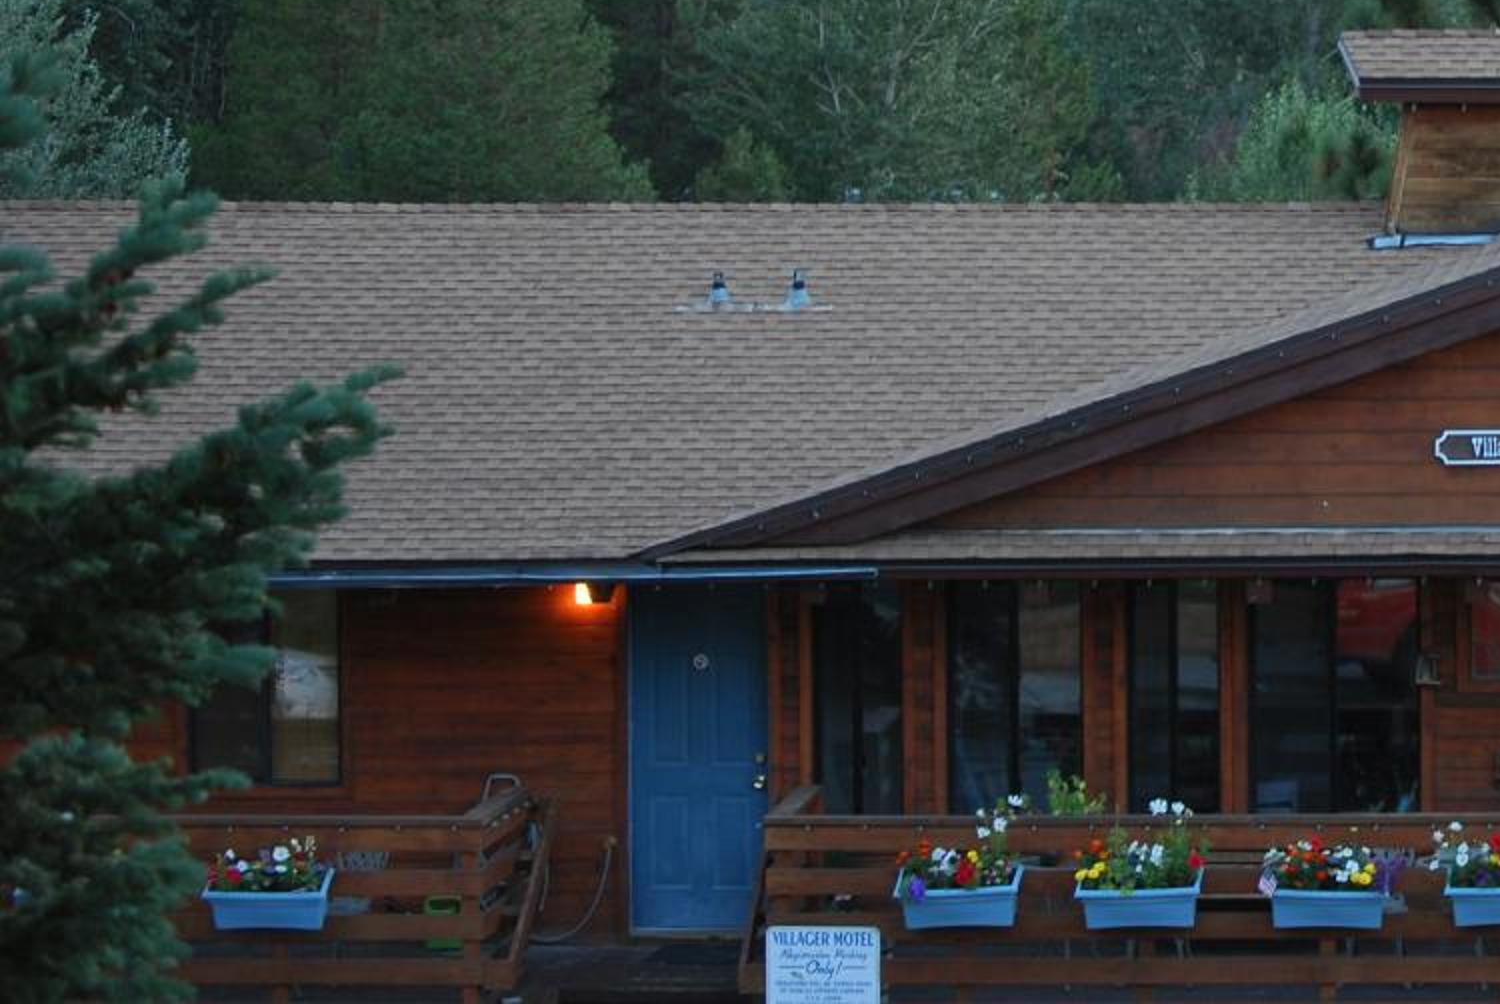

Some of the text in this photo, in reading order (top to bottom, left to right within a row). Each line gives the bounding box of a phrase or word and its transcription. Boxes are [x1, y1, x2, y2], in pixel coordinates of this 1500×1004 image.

[772, 930, 874, 947] VILLAGER MOTEL
[805, 959, 843, 979] Only!
